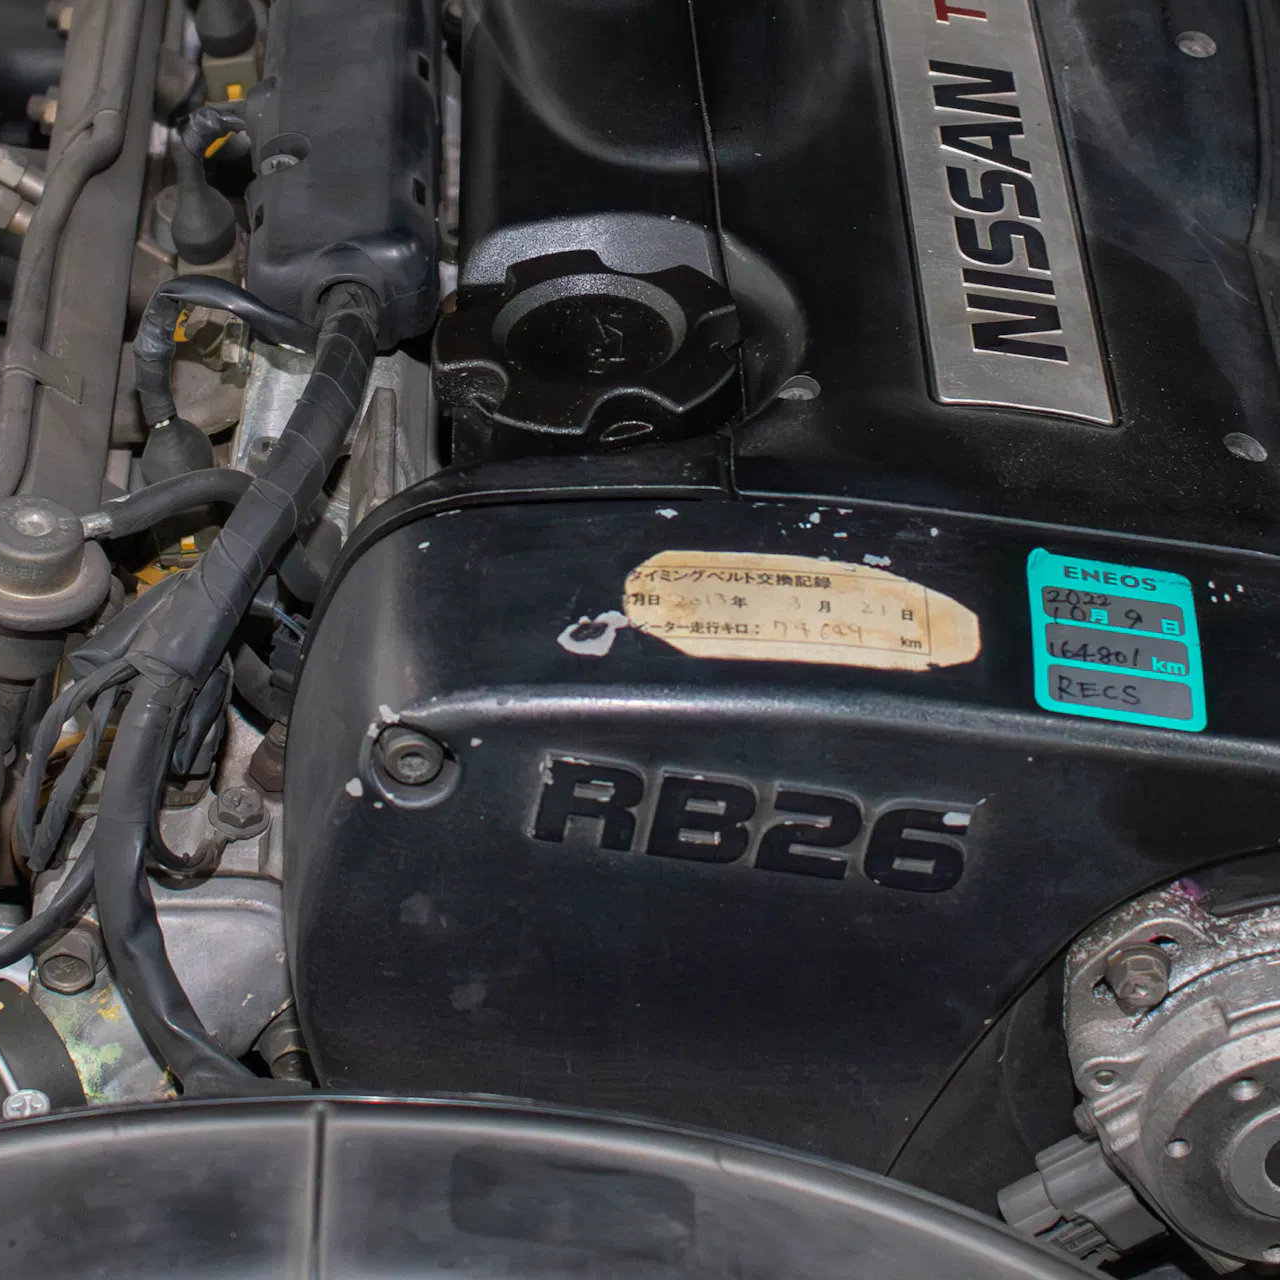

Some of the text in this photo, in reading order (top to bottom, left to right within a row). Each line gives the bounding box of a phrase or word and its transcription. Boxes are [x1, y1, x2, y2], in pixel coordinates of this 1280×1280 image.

[928, 59, 1070, 365] NISSAN
[1063, 565, 1157, 592] ENEOS
[731, 595, 748, 608] 年
[818, 600, 831, 613] 月
[902, 608, 913, 621] 日
[1046, 590, 1112, 607] 2022
[1053, 605, 1180, 635] 10 月 9 日
[900, 635, 922, 649] km
[1151, 656, 1186, 676] km
[1057, 674, 1142, 706] RECS
[526, 749, 976, 894] RB26
